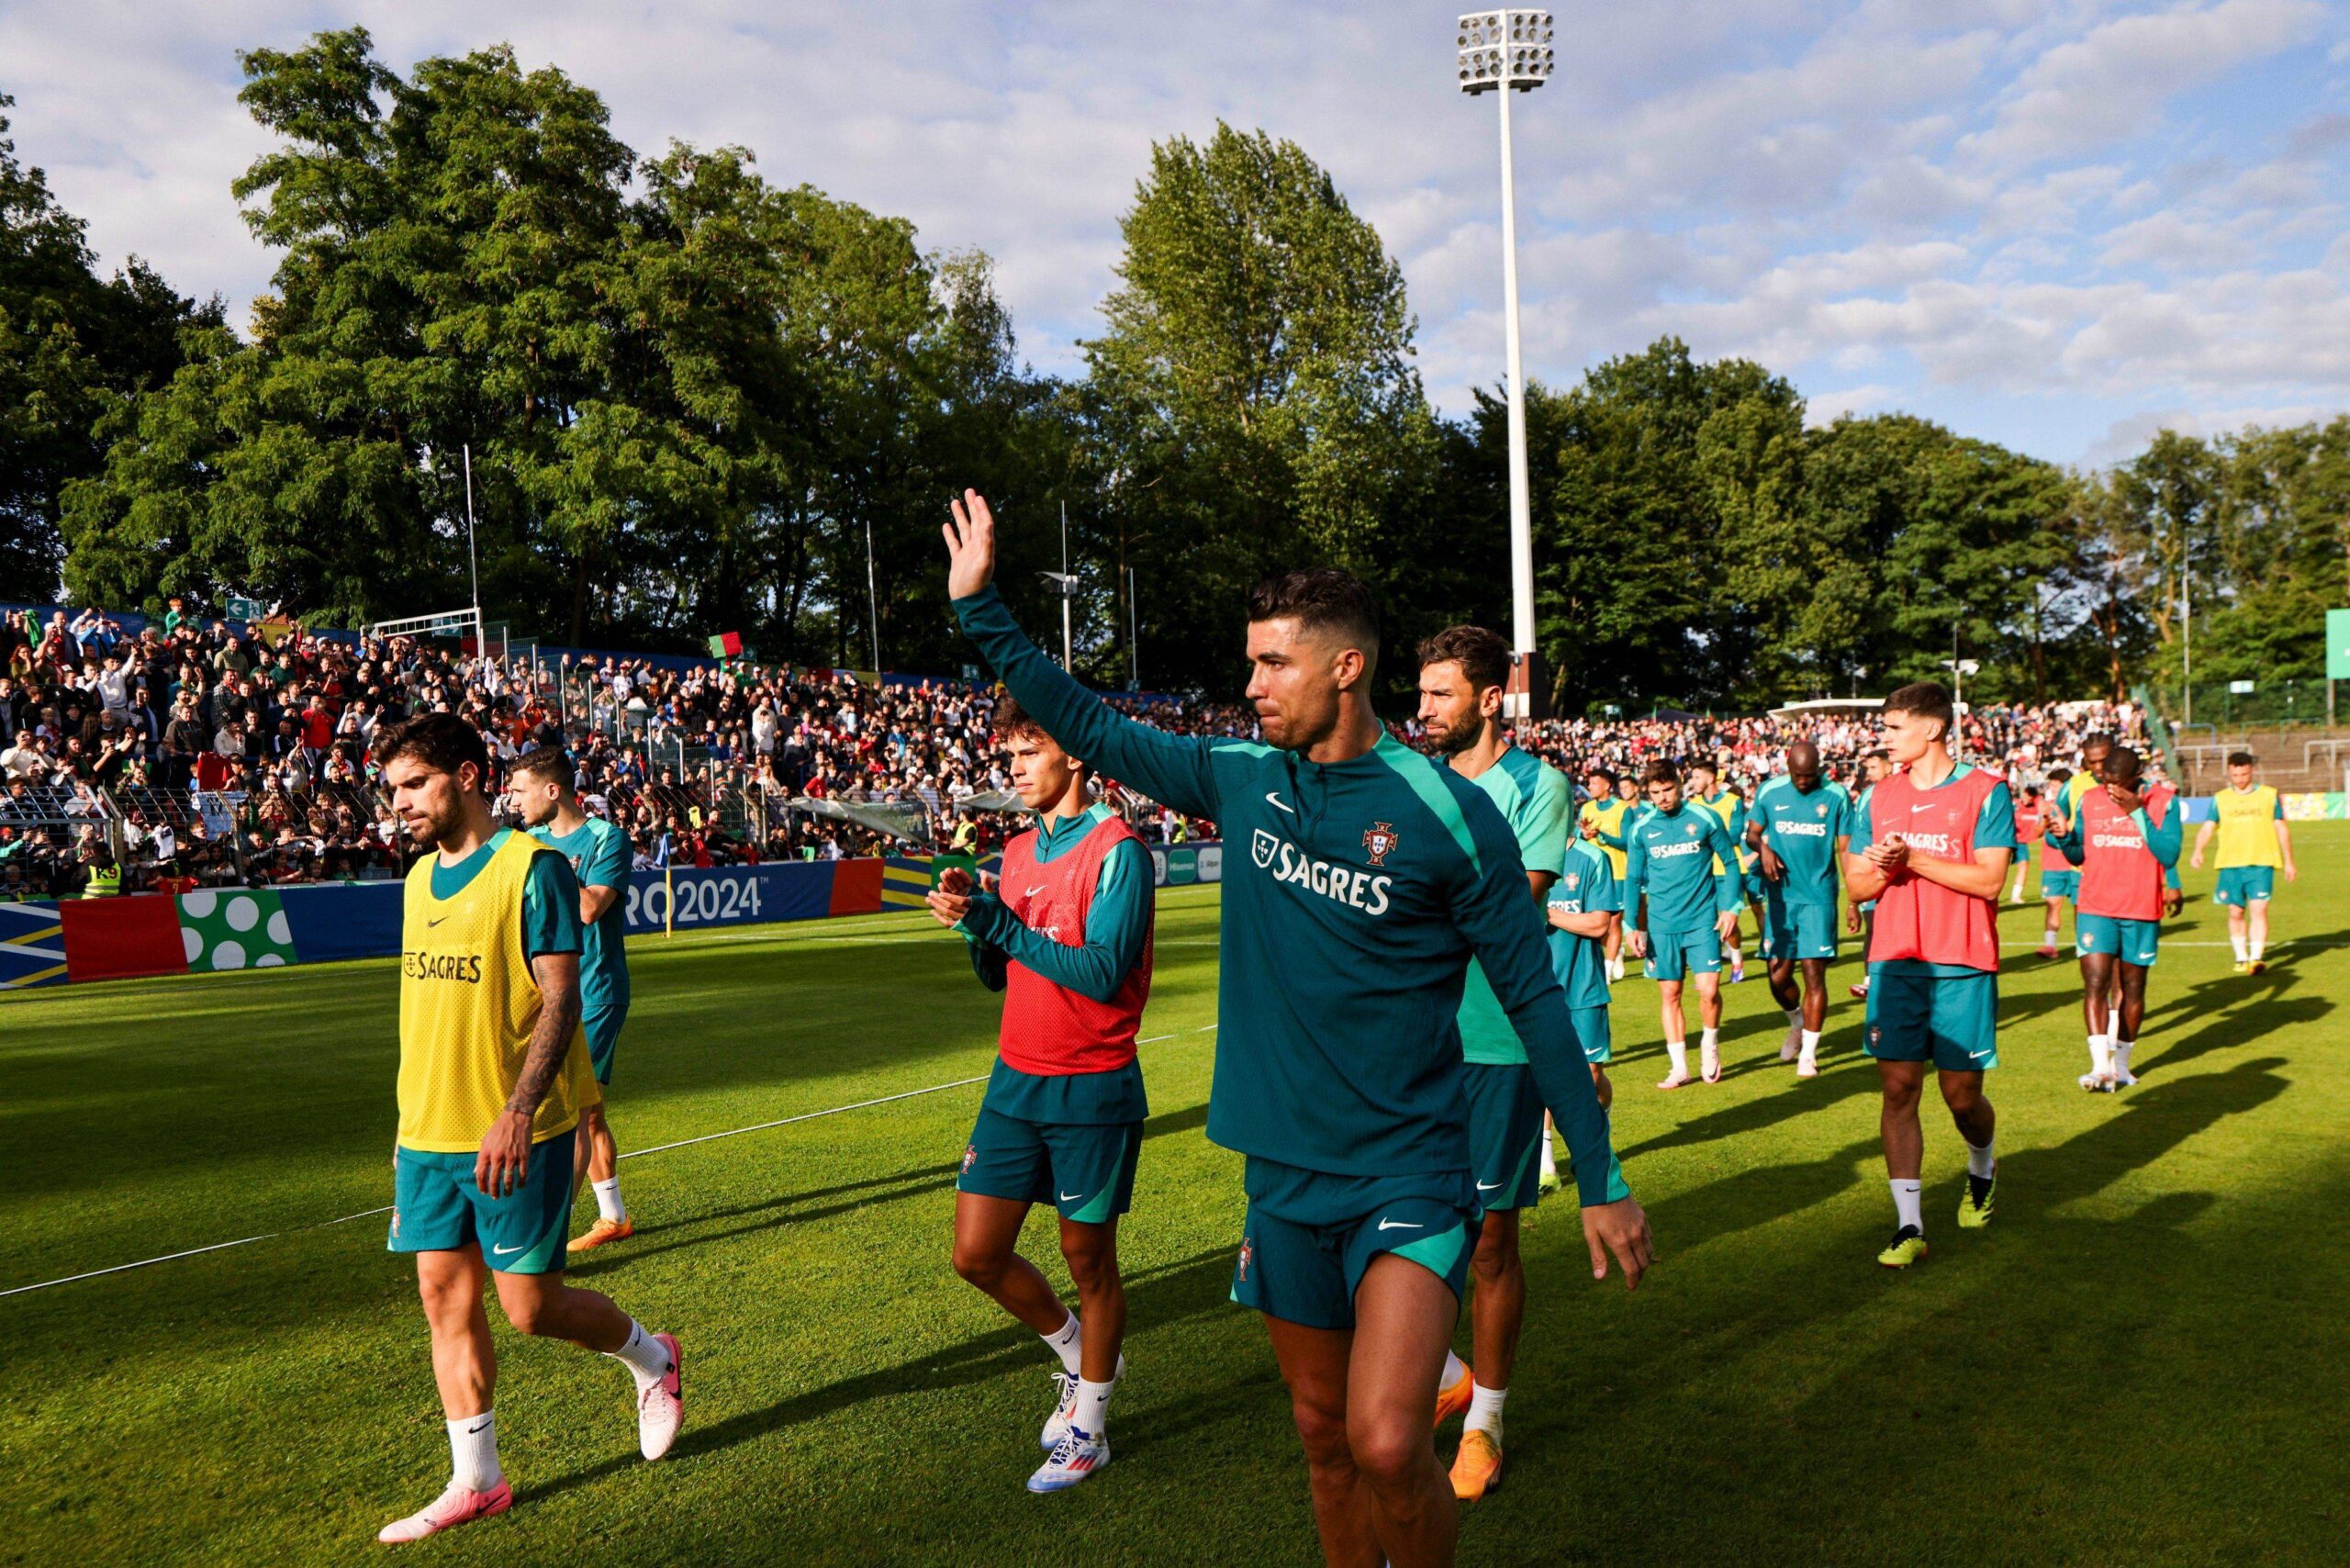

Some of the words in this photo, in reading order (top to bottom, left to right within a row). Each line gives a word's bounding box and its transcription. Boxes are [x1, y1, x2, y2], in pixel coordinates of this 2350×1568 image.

[1785, 822, 1826, 836] SAGRES
[1660, 840, 1700, 857] SAGRES
[2105, 834, 2143, 850] SAGRES
[95, 867, 118, 879] K9
[1272, 842, 1393, 916] SAGRES
[418, 951, 482, 984] SAGRES
